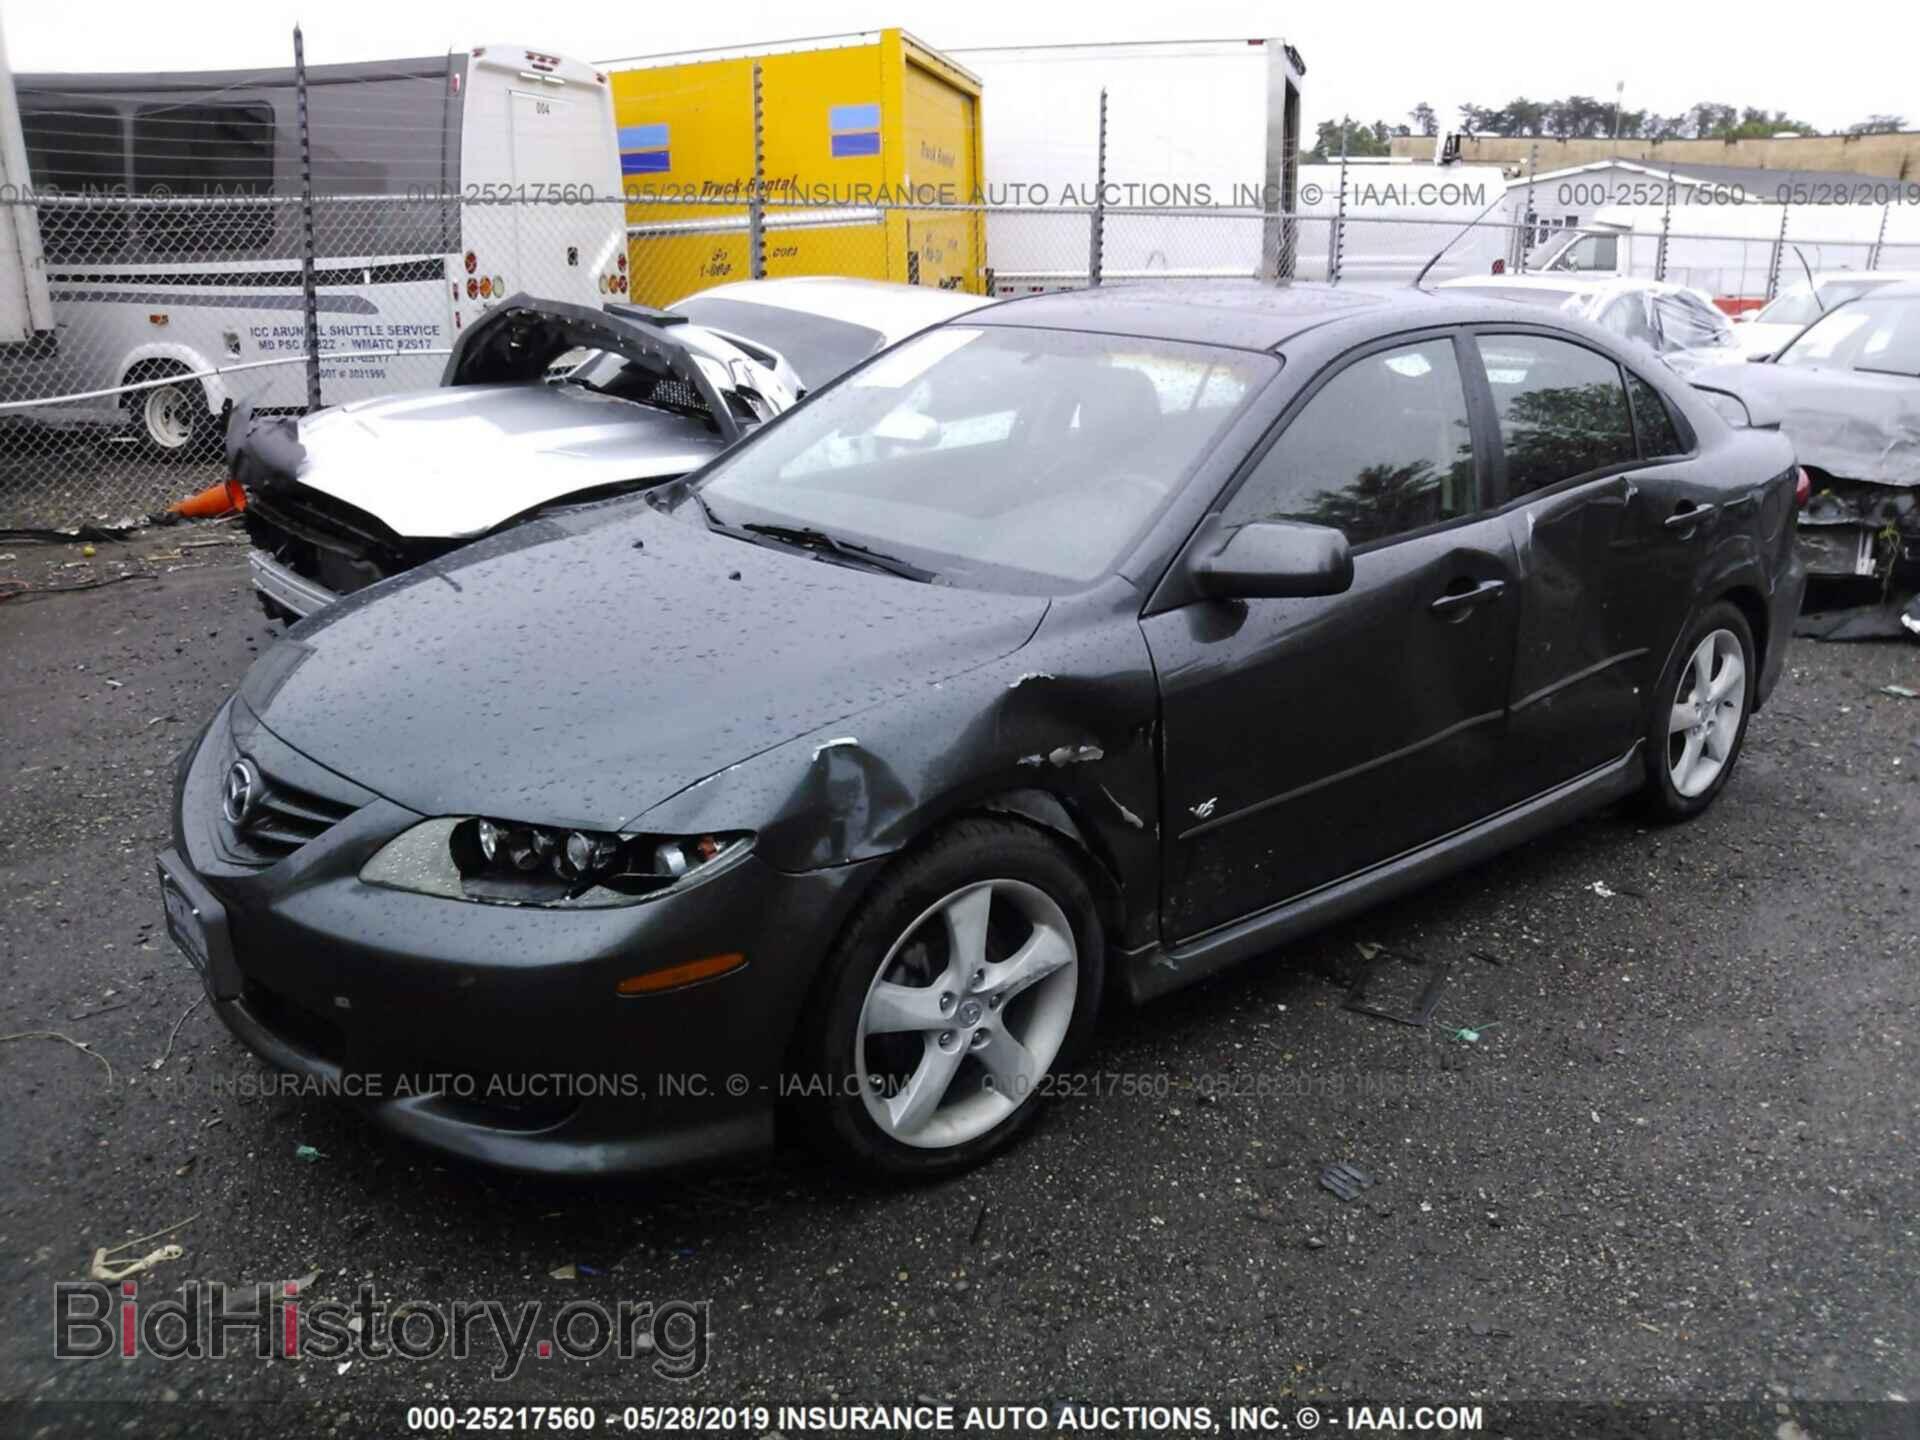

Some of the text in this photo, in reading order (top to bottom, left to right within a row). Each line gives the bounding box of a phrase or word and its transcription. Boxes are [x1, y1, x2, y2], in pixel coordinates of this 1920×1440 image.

[535, 101, 550, 115] 004
[702, 174, 798, 196] Truck Rntal
[329, 325, 384, 337] SHUTTLE
[387, 325, 440, 336] SERVICE
[351, 339, 394, 350] WMATC
